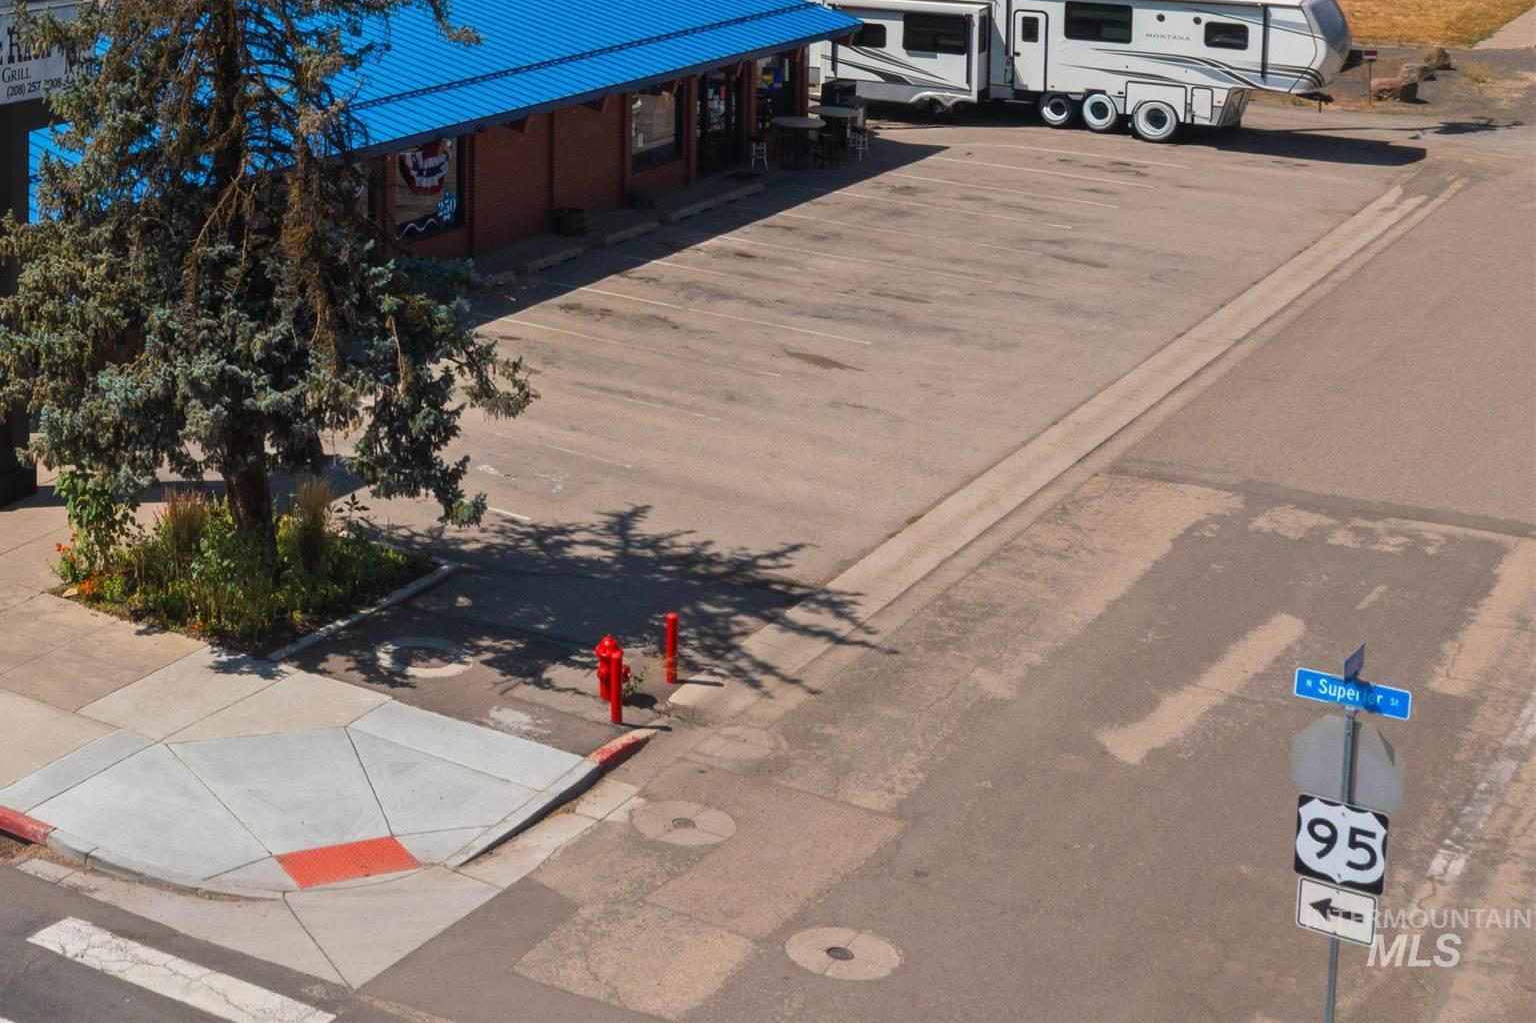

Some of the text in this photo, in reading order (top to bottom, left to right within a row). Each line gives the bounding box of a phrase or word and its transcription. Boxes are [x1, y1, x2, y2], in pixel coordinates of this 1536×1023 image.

[7, 25, 52, 64] RA
[1146, 33, 1190, 41] MONTANA
[2, 67, 32, 84] GRILL
[6, 83, 26, 100] (208)
[27, 80, 41, 94] 257
[1306, 678, 1400, 706] N Superior St
[1307, 818, 1377, 871] 95
